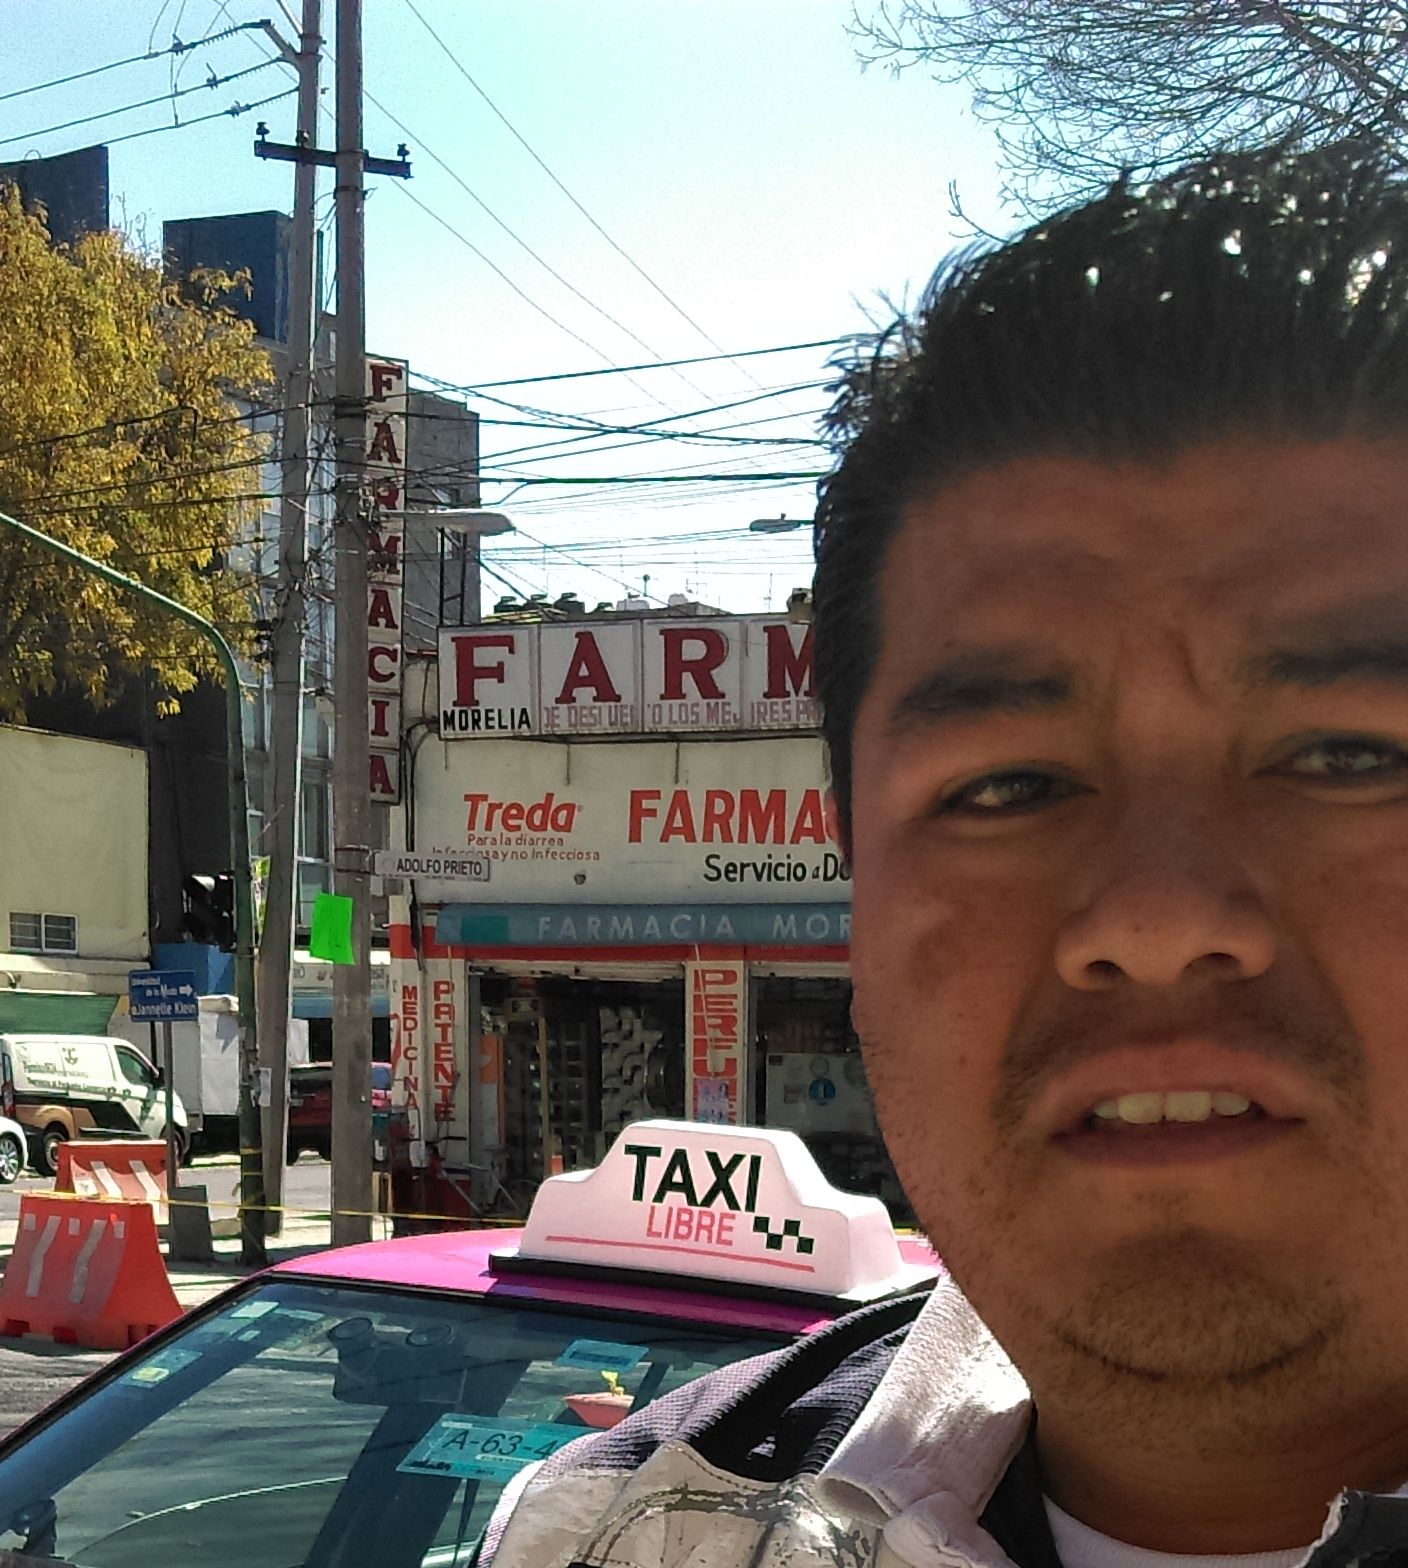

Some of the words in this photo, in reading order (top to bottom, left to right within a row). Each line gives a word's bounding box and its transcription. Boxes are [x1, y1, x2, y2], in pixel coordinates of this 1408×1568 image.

[443, 707, 531, 731] MORELIA
[669, 703, 700, 725] LOS
[464, 792, 576, 833] Treda
[628, 788, 832, 844] FARMA
[515, 833, 564, 847] diarrea
[396, 858, 441, 874] ADOLFO
[444, 860, 483, 876] PRIETO
[532, 849, 600, 861] Infecciosa
[703, 853, 807, 882] Servicio
[538, 914, 735, 941] FARMACIA
[433, 980, 456, 1122] PATENTE
[624, 1144, 762, 1213] TAXI
[646, 1204, 737, 1246] LIBRE
[442, 1428, 560, 1461] A-63-4
